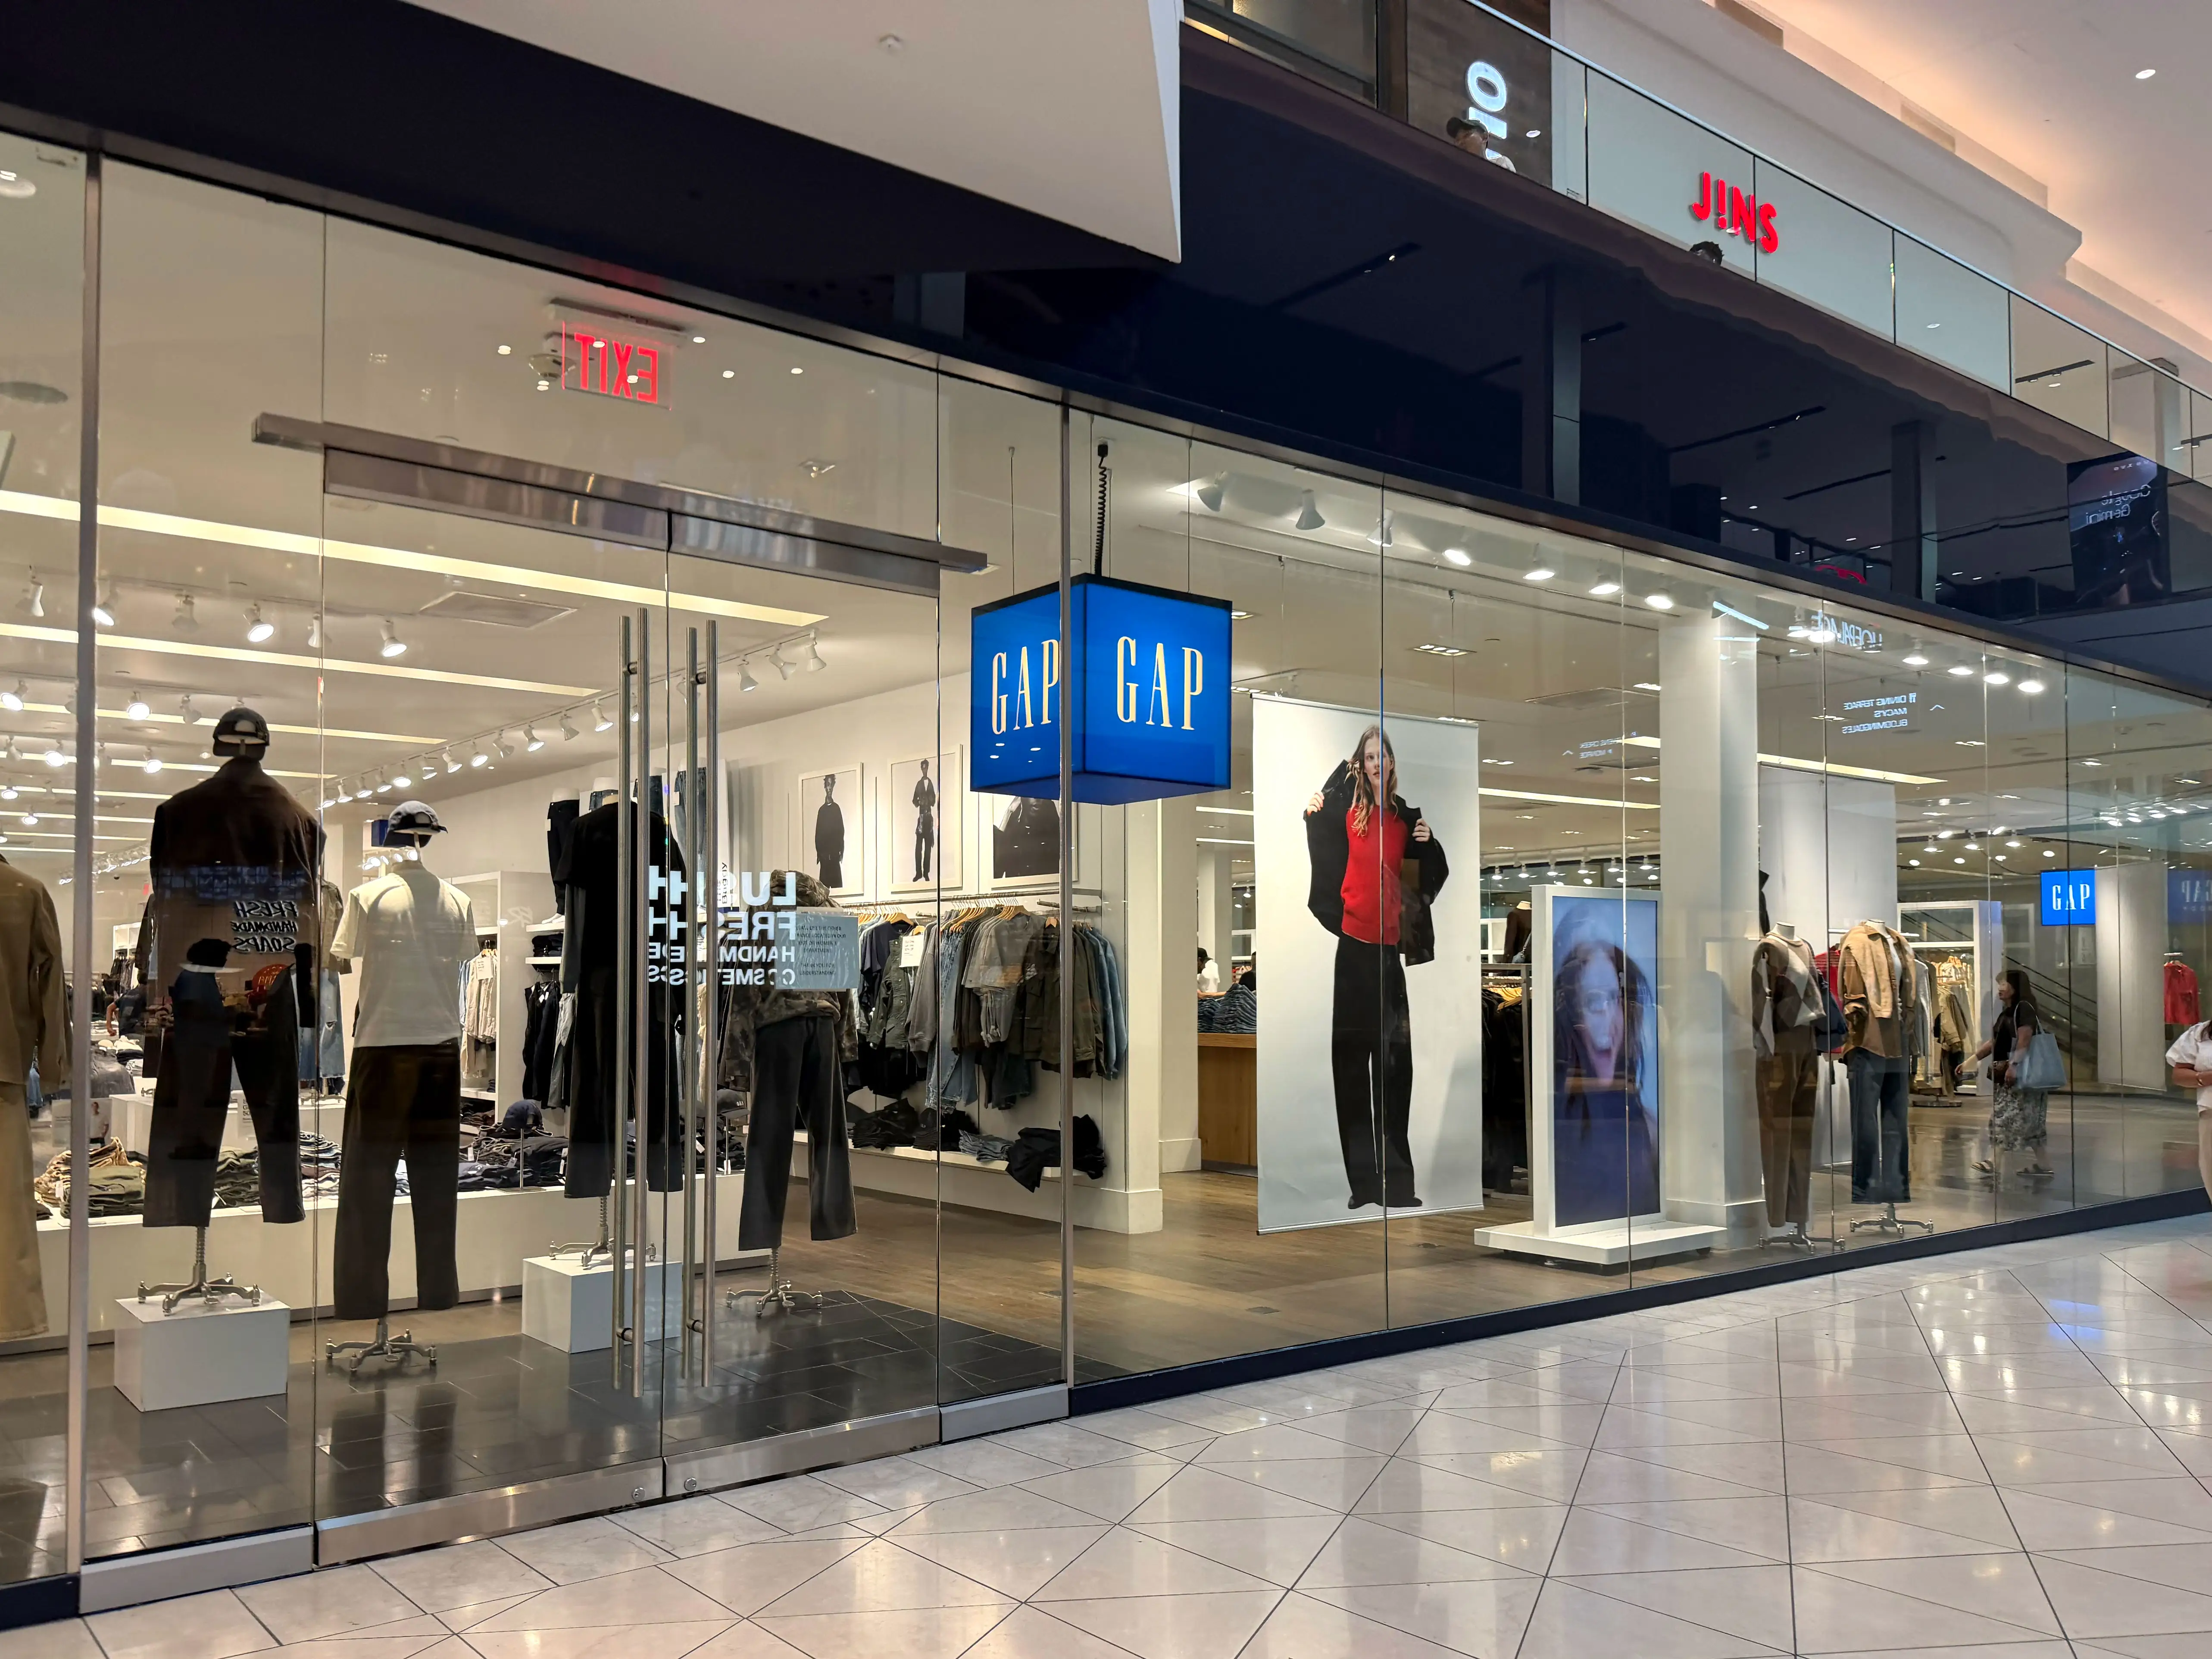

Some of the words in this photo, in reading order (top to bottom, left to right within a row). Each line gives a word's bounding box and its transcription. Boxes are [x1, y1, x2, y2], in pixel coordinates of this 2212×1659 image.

[992, 639, 1059, 735] GAP
[1117, 636, 1203, 731] GAP
[2052, 884, 2090, 911] GAP
